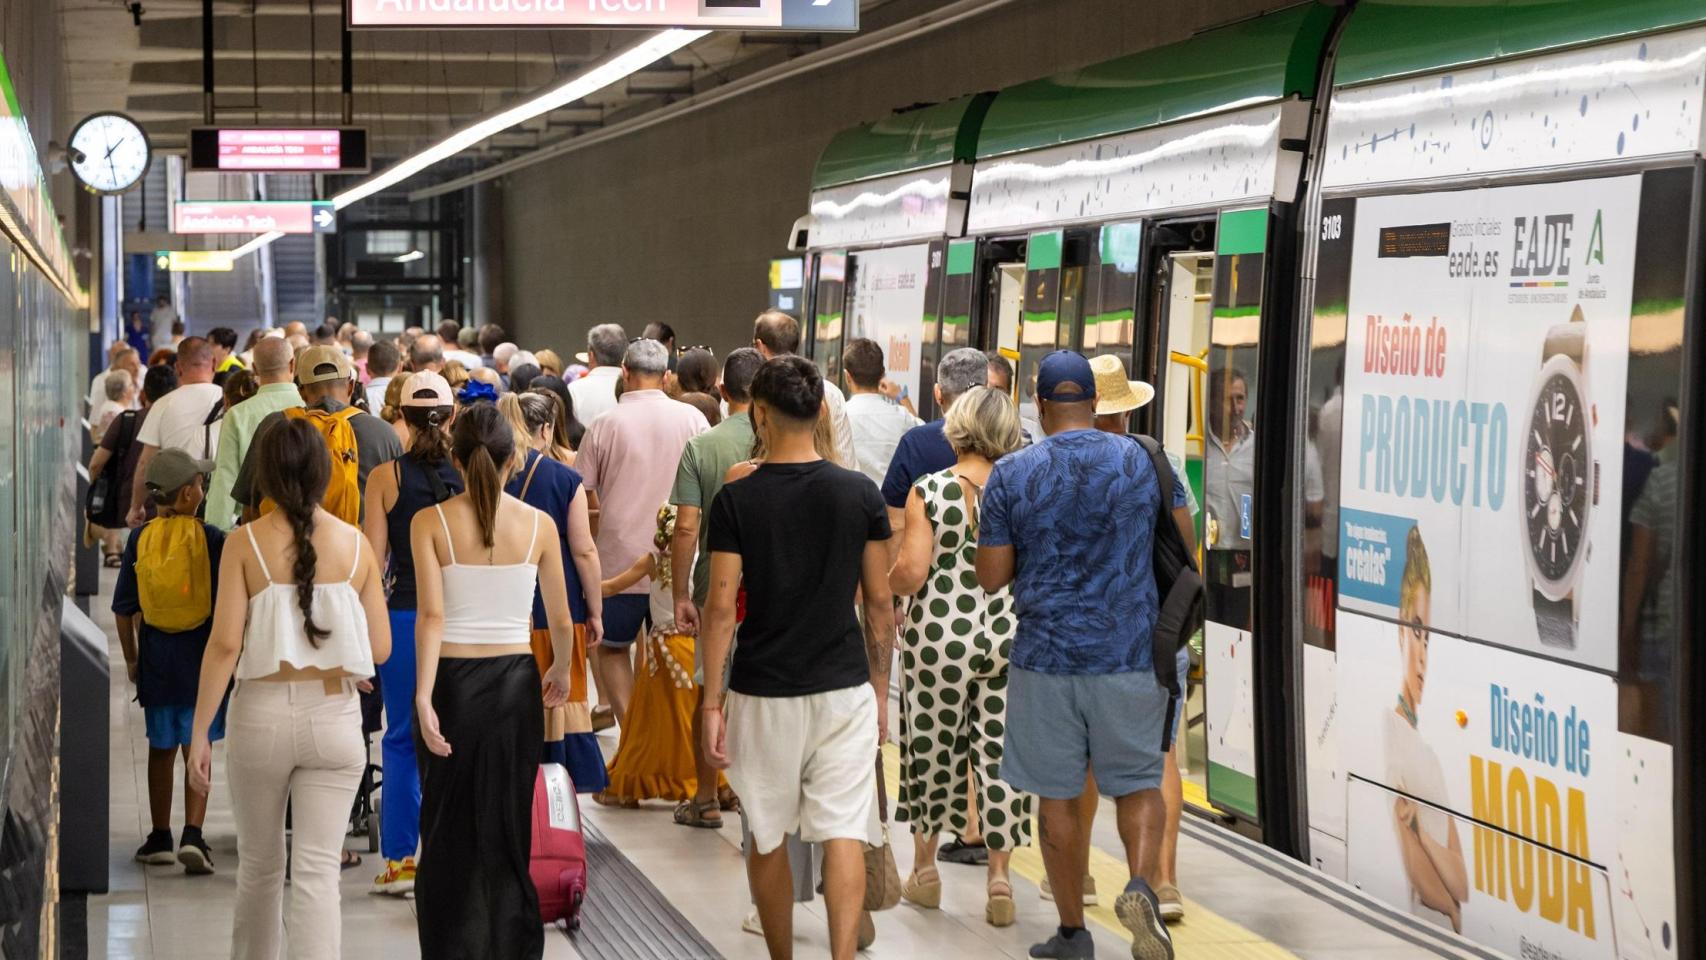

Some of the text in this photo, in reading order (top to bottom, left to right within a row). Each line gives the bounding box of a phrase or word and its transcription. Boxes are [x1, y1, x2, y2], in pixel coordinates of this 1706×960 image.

[246, 214, 276, 228] Tech
[1321, 214, 1342, 241] 3103
[1510, 214, 1573, 277] EADE
[1449, 242, 1499, 278] eade.es
[1364, 312, 1446, 378] Diseño de
[1552, 391, 1566, 421] 12
[1359, 393, 1508, 512] PRODUCTO
[1490, 683, 1591, 778] Diseño de
[1469, 753, 1597, 941] MODA
